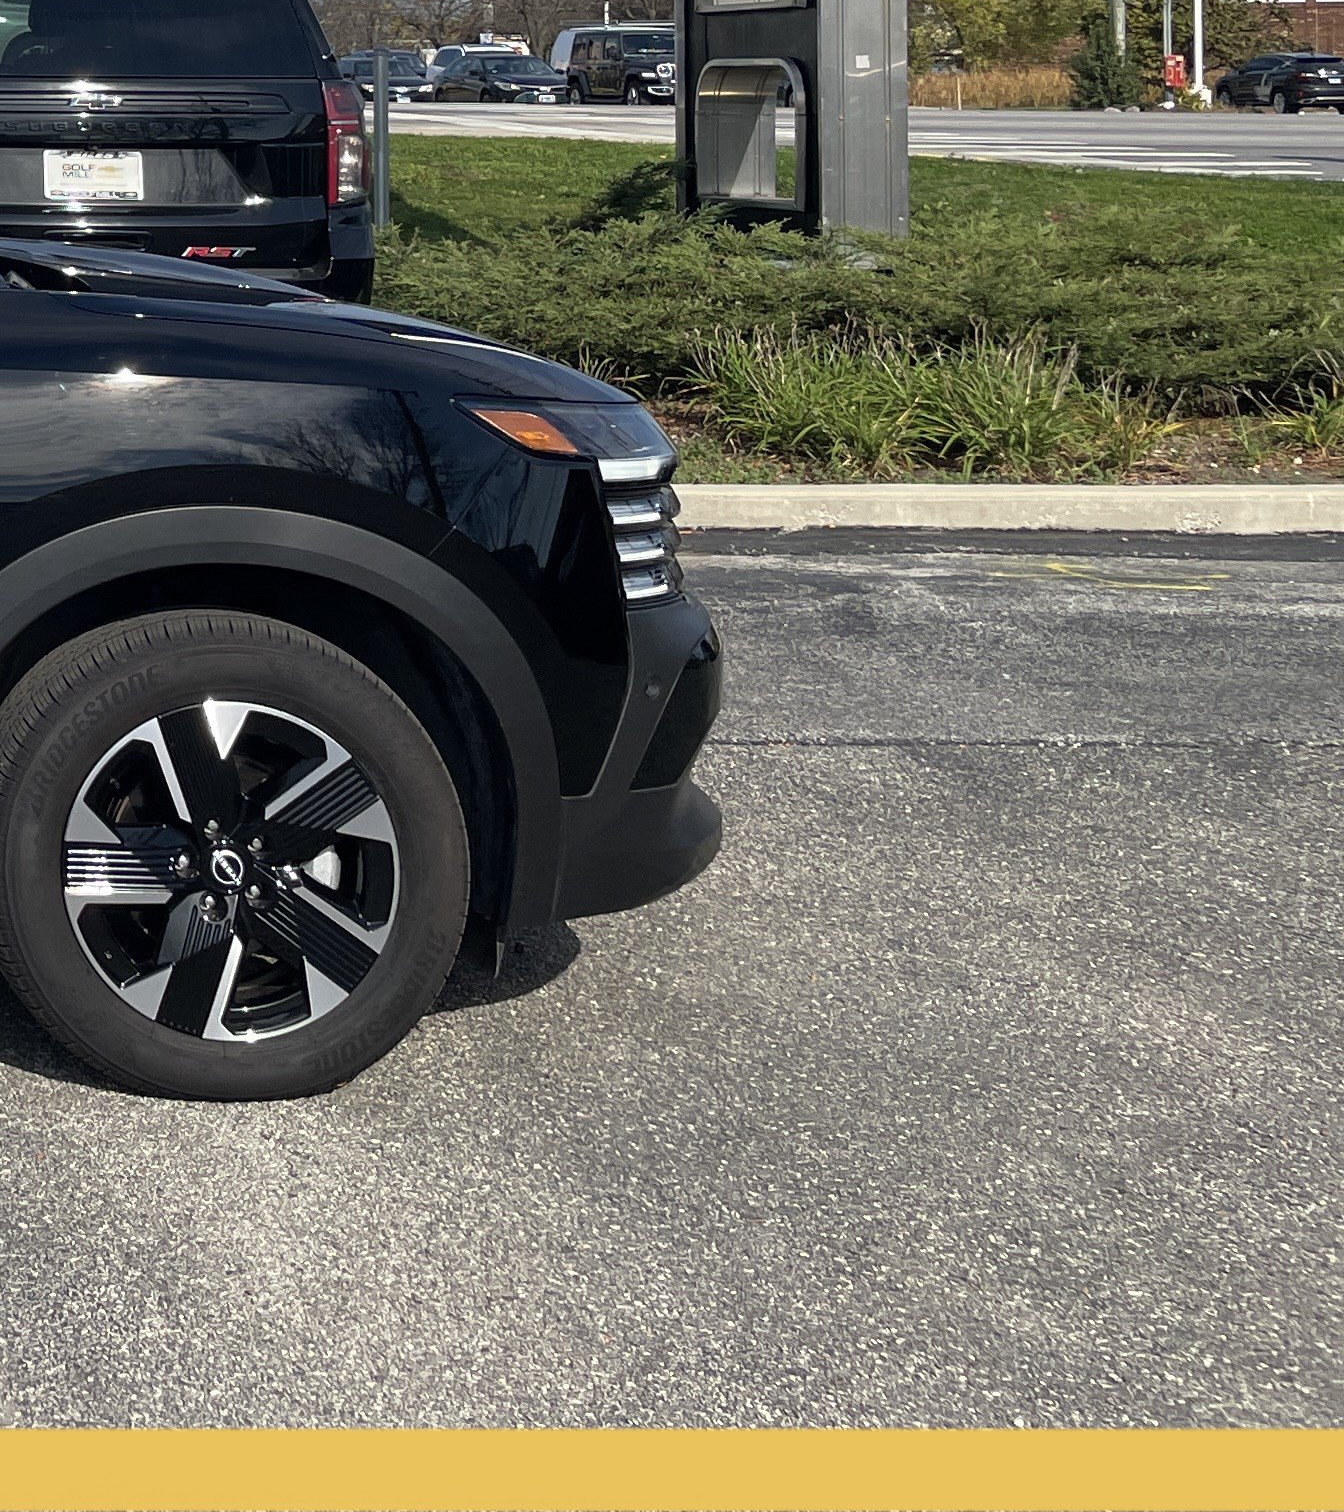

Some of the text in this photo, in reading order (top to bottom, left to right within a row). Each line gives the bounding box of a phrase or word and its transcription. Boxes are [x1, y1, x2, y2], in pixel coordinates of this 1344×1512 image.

[62, 163, 97, 172] GOLF
[62, 171, 92, 179] MILL
[181, 246, 257, 258] RST
